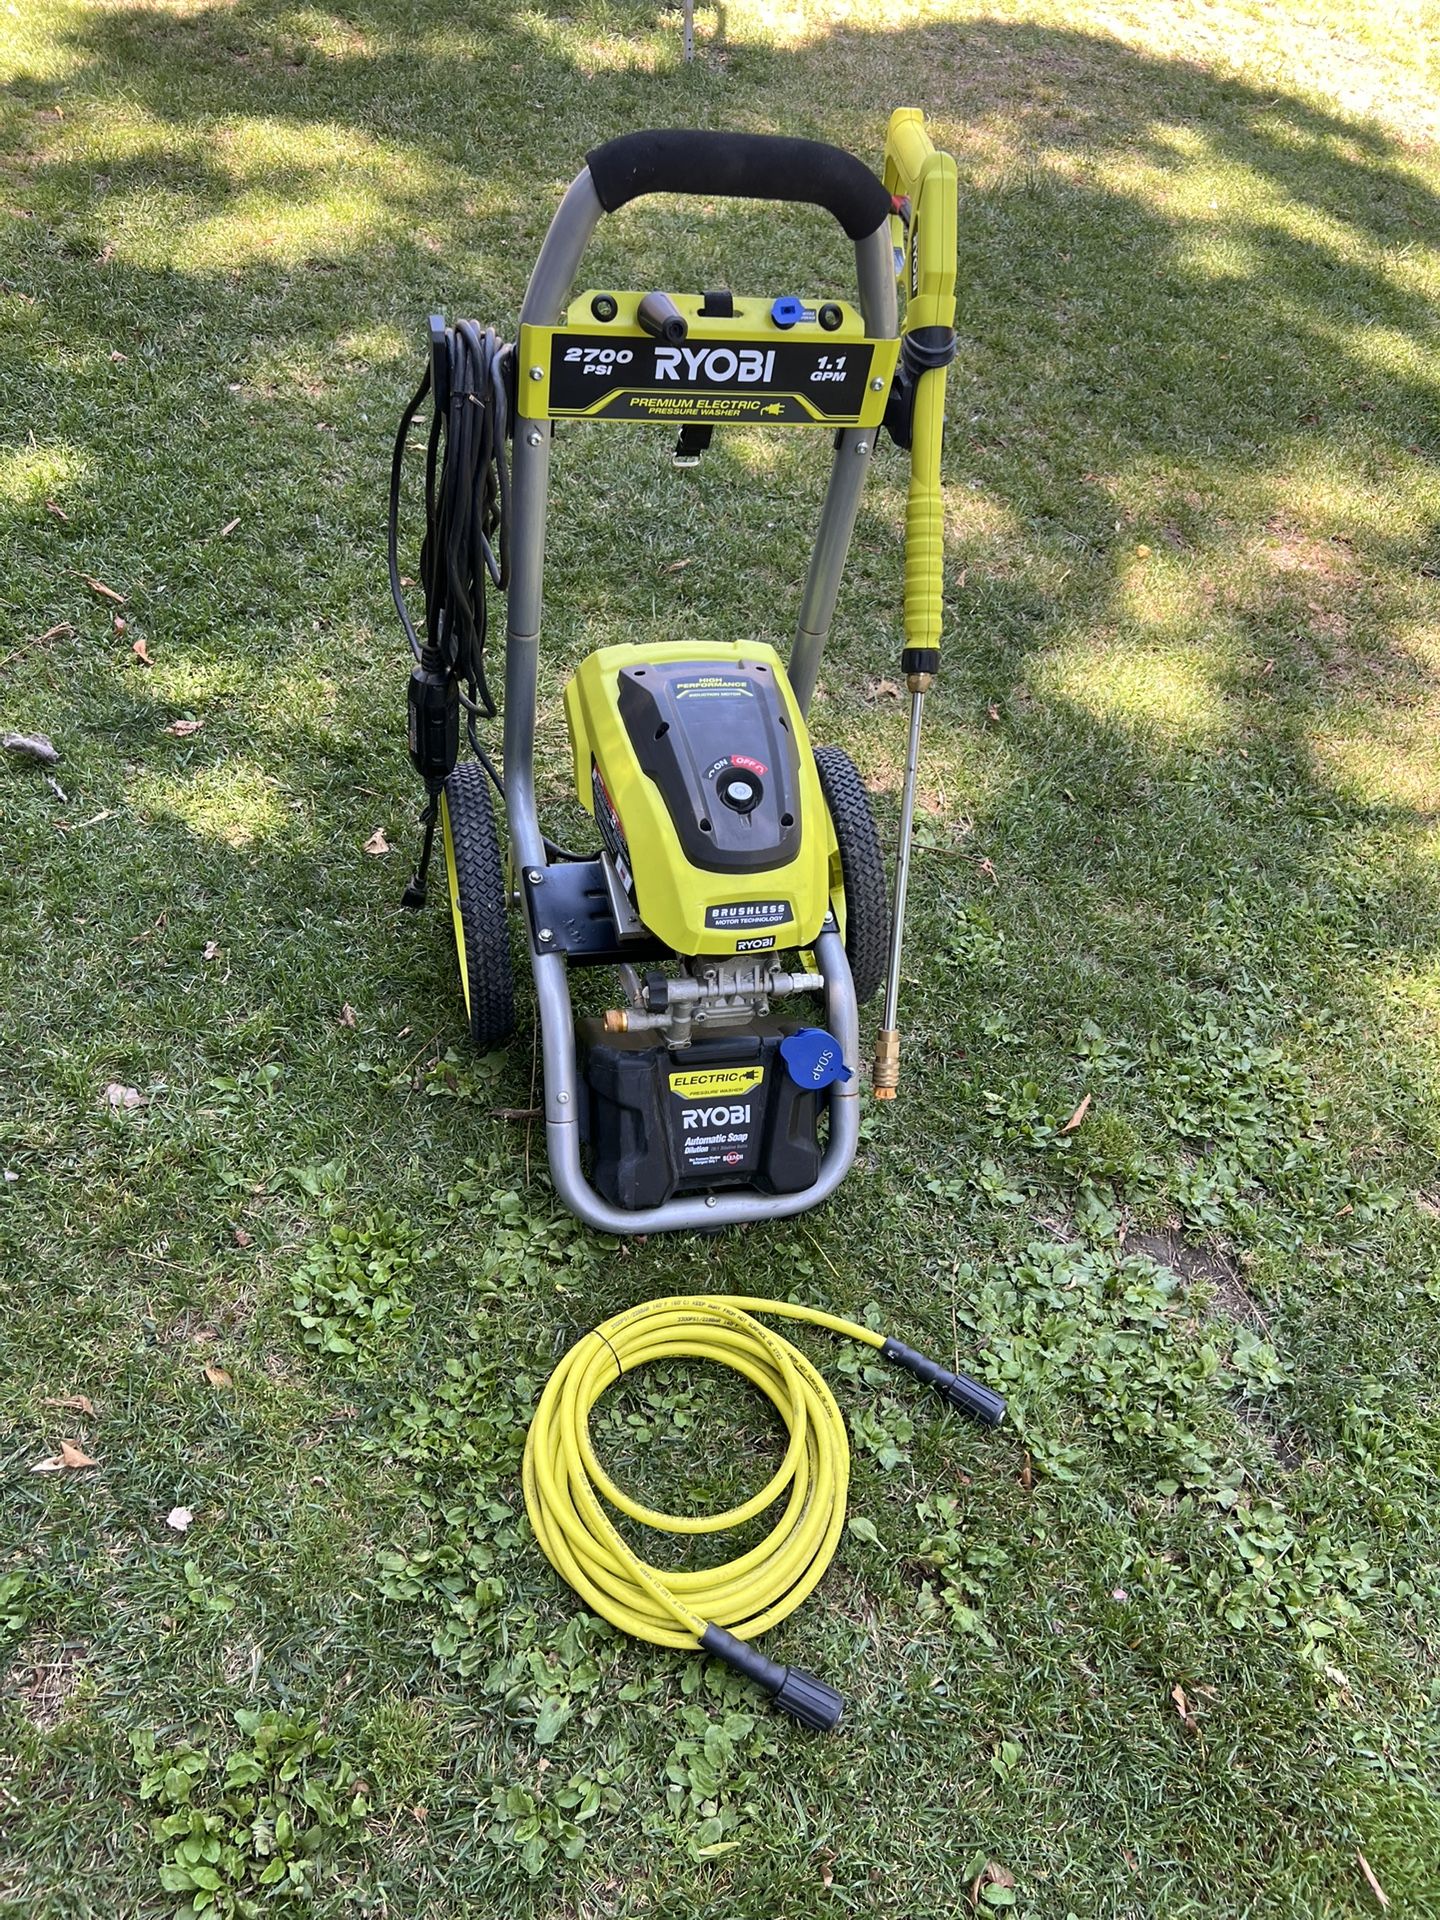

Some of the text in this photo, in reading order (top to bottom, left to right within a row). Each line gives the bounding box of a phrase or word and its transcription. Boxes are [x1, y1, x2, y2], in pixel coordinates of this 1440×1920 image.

[563, 347, 634, 364] 2700
[583, 364, 613, 375] PSI
[654, 346, 776, 383] RYOBI
[817, 356, 847, 370] 1.1
[810, 371, 847, 382] GPM
[629, 397, 761, 410] PREMIUM ELECTRIC
[648, 407, 698, 415] PRESSURE
[713, 758, 728, 770] ON
[736, 757, 757, 766] OFF
[712, 904, 785, 917] BRUSHLESS
[715, 915, 783, 926] MOTOR TECHNOLOGY
[738, 937, 774, 950] RYOBI
[812, 1049, 834, 1081] SOAP
[674, 1072, 739, 1086] ELECTRIC
[689, 1089, 719, 1097] PRESSURE
[681, 1104, 751, 1130] RYOBI
[684, 1132, 749, 1146] Automatic Soap
[684, 1145, 709, 1154] Dilution
